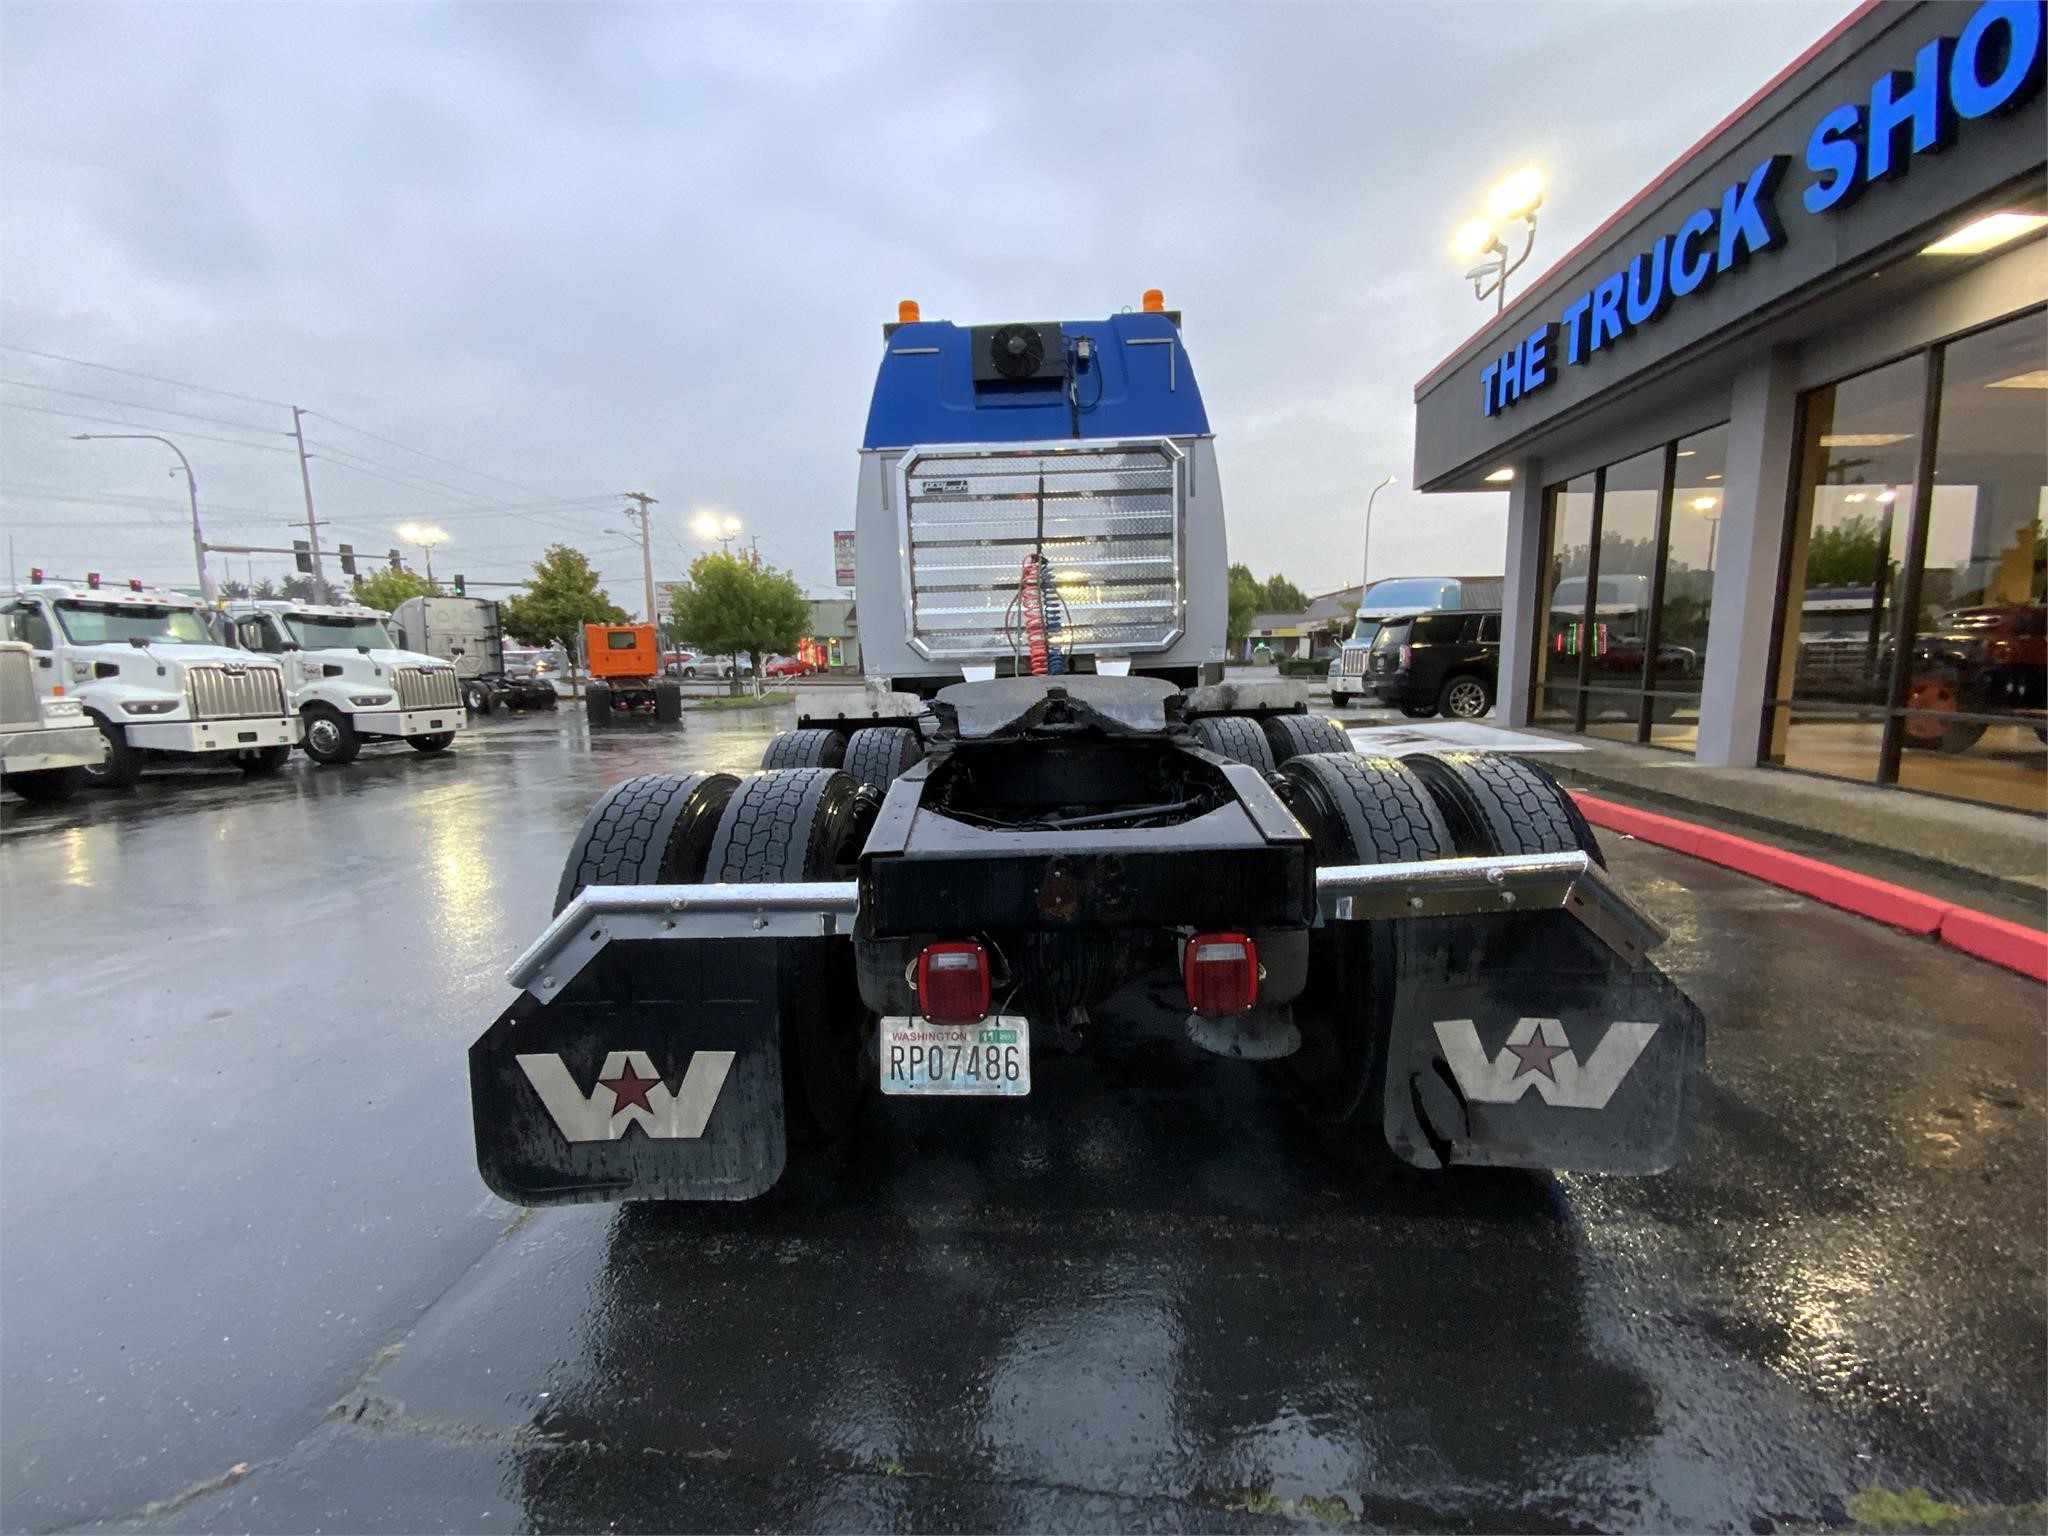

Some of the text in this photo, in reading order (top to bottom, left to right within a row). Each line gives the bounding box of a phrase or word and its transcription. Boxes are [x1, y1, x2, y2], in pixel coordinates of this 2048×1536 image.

[1479, 322, 1553, 417] THE
[1562, 155, 1786, 365] TRUCK
[892, 1031, 967, 1042] WASHINGTON
[890, 1045, 1020, 1081] RP07486
